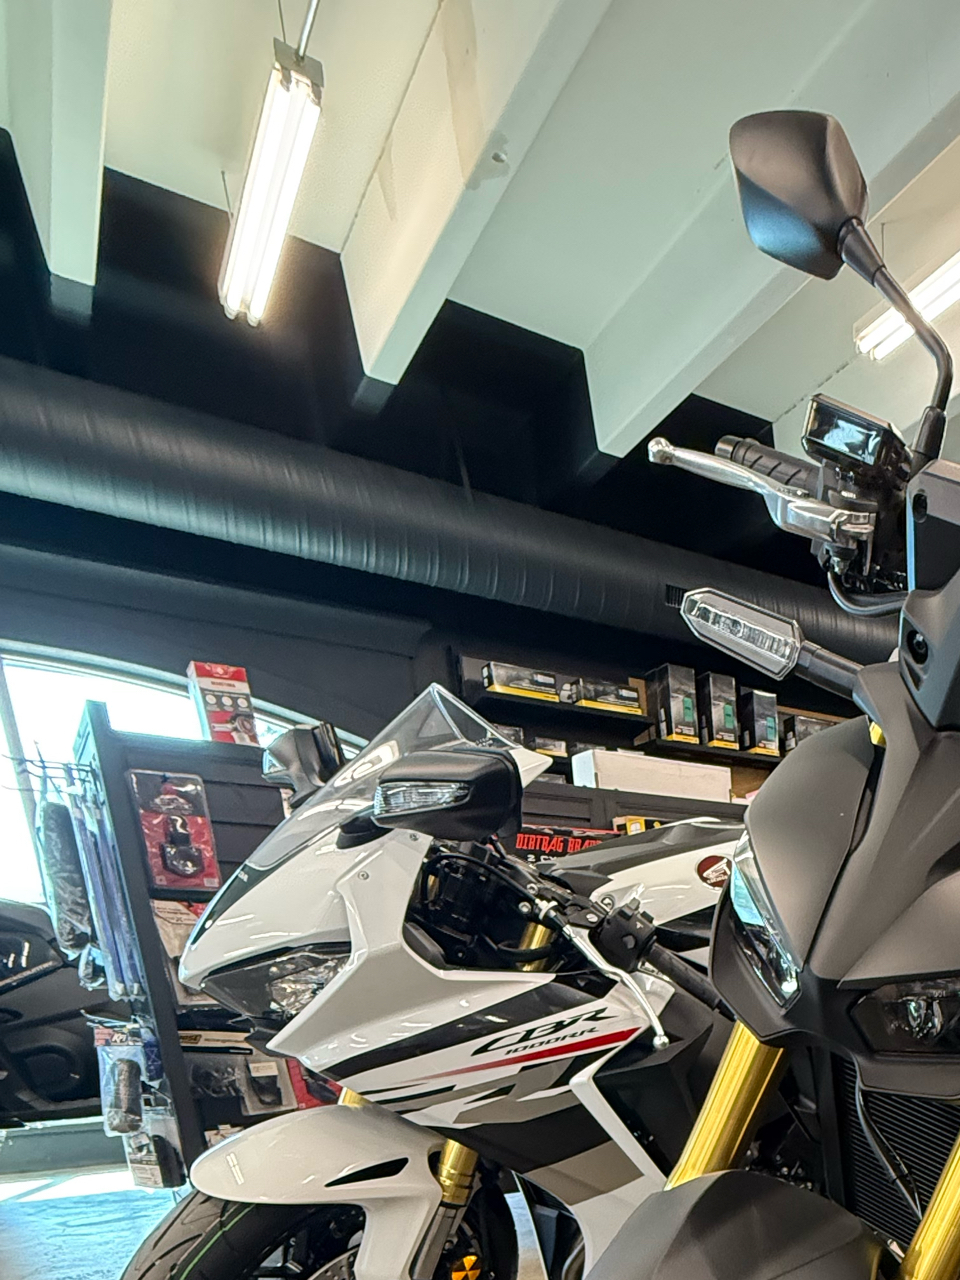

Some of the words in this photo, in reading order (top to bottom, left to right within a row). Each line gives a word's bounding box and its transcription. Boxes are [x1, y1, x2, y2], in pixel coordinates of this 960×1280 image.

[516, 833, 565, 853] DIRTBAG
[527, 854, 536, 862] 2
[470, 1007, 619, 1057] CBR
[504, 1026, 600, 1056] 1000RR
